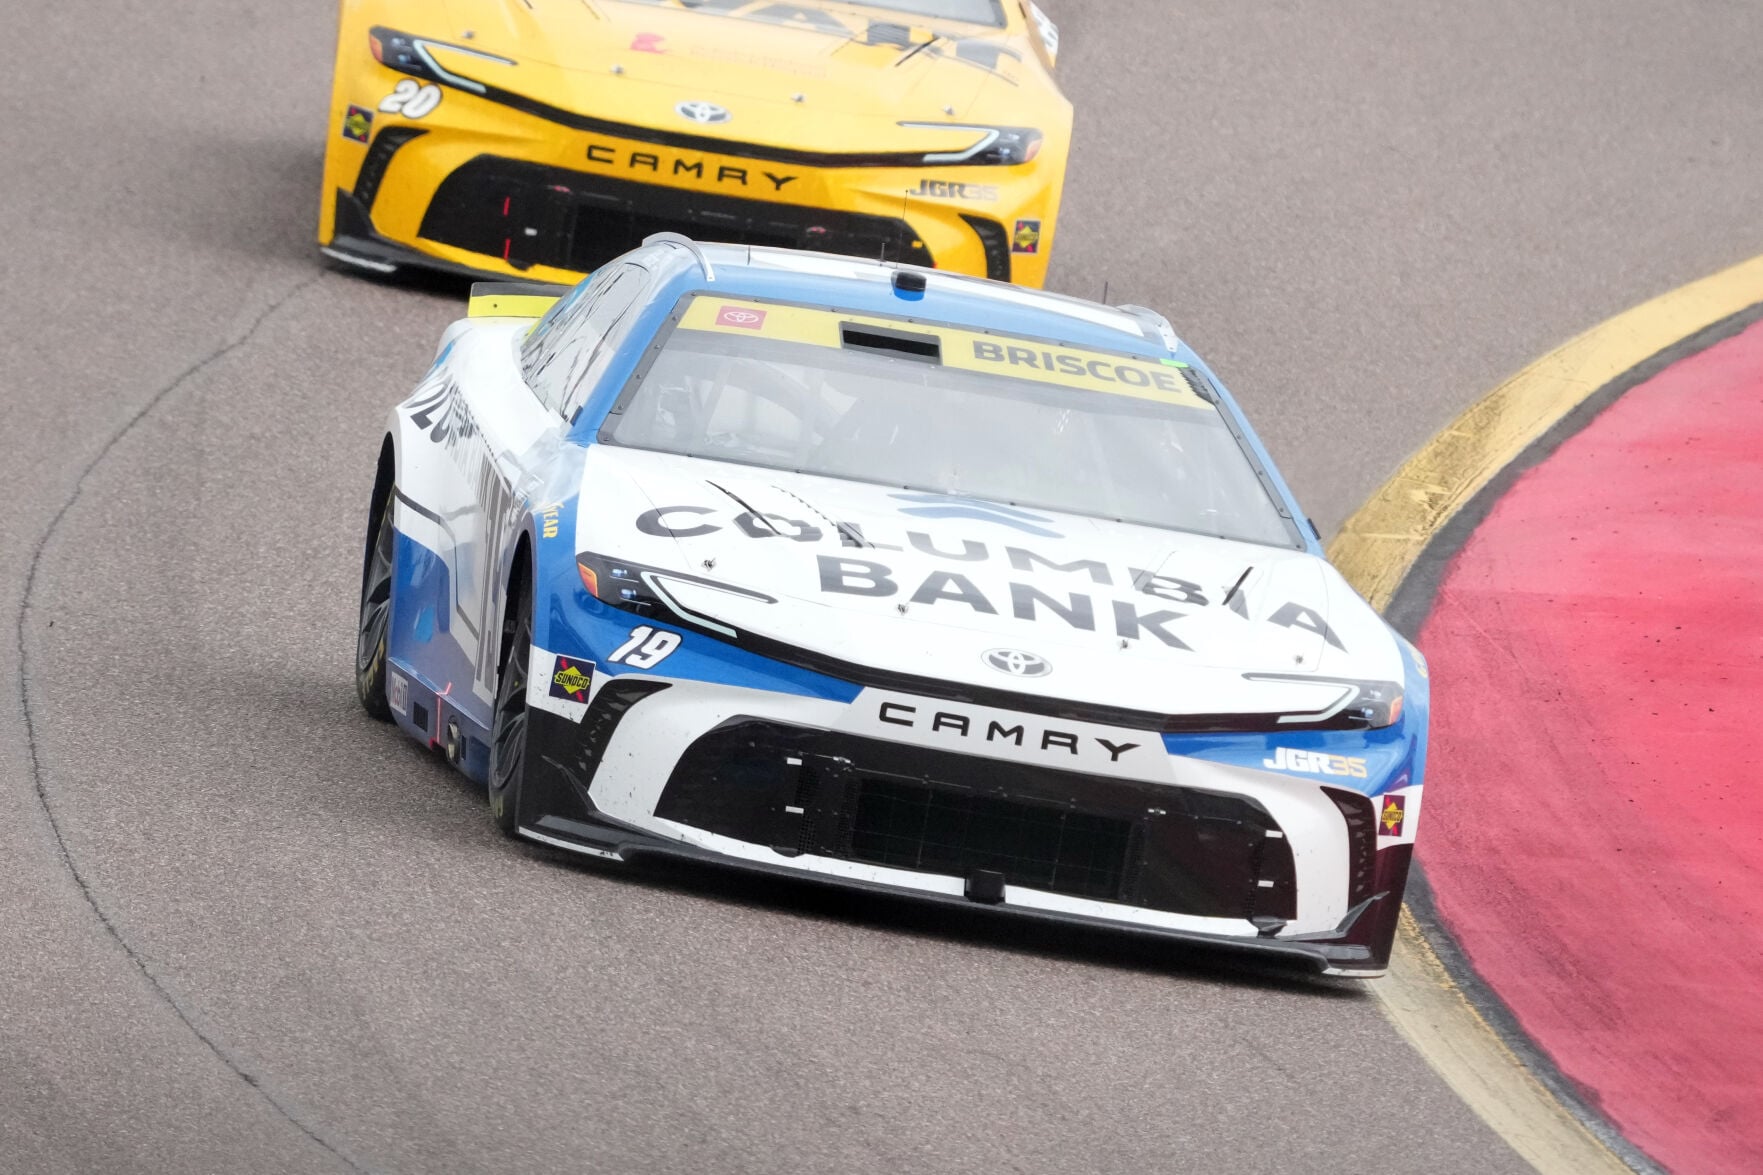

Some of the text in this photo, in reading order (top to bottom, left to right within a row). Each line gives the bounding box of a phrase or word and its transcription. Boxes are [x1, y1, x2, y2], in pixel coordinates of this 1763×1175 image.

[377, 77, 442, 119] 20
[586, 144, 799, 190] CAMRY
[909, 179, 999, 201] JGR35
[973, 340, 1182, 393] BRISCOE
[635, 505, 1349, 654] COLUMBIA
[816, 554, 1196, 653] BANK
[607, 624, 683, 670] 19
[555, 672, 590, 689] SUNOCO
[878, 701, 1142, 761] CAMRY
[1263, 747, 1368, 778] JGR35
